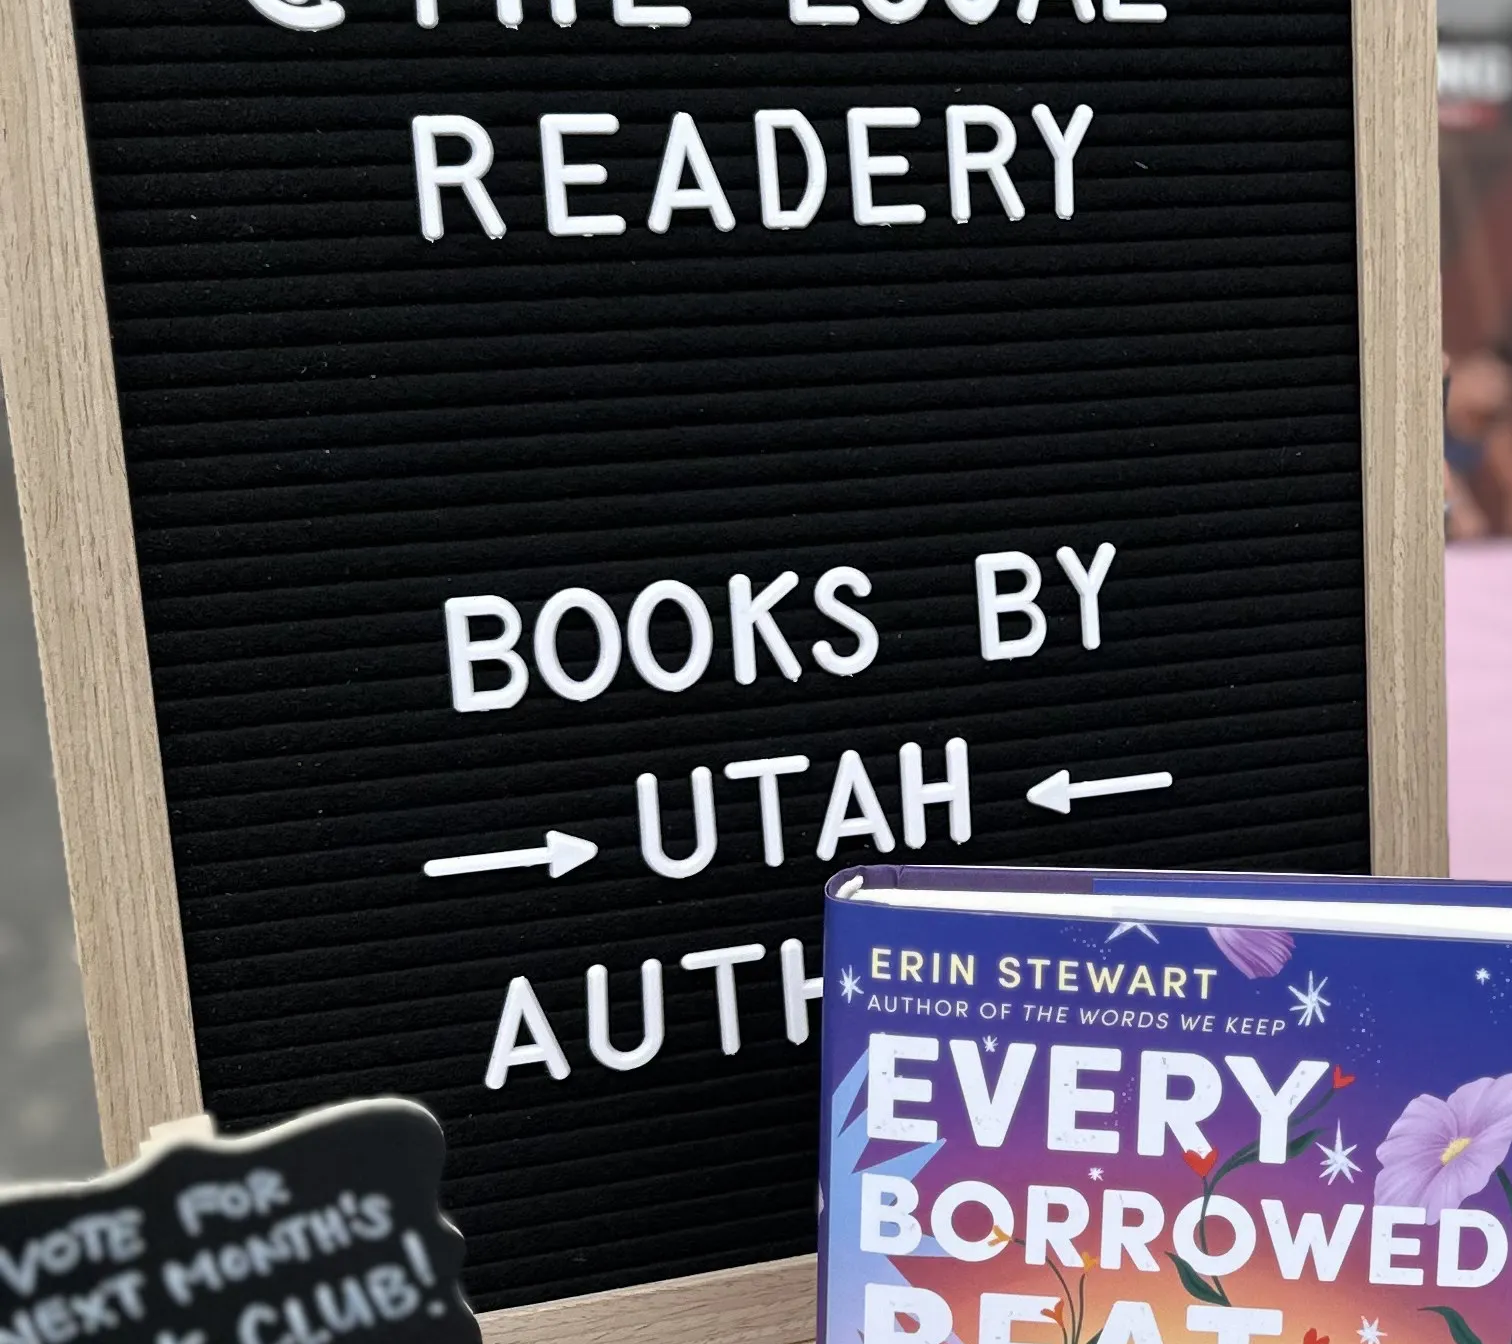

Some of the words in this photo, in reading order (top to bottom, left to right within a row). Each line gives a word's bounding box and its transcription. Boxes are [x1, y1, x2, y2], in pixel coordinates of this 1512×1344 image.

[411, 104, 1094, 241] READERY
[444, 566, 880, 713] BOOKS
[975, 542, 1117, 662] BY
[636, 737, 972, 880] UTAH
[867, 993, 969, 1019] AUTHOR
[979, 1002, 1013, 1021] OF
[1022, 1004, 1068, 1024] THE
[1079, 1008, 1170, 1030] WORDS
[1180, 1013, 1215, 1033] WE
[1225, 1016, 1287, 1037] KEEP
[871, 947, 976, 985] ERIN
[998, 956, 1219, 1000] STEWART
[866, 1033, 1329, 1164] EVERY
[0, 1207, 146, 1296] VOTE
[176, 1167, 292, 1237] FOR
[162, 1190, 393, 1308] MONTH'S
[860, 1172, 1508, 1288] BORROWED
